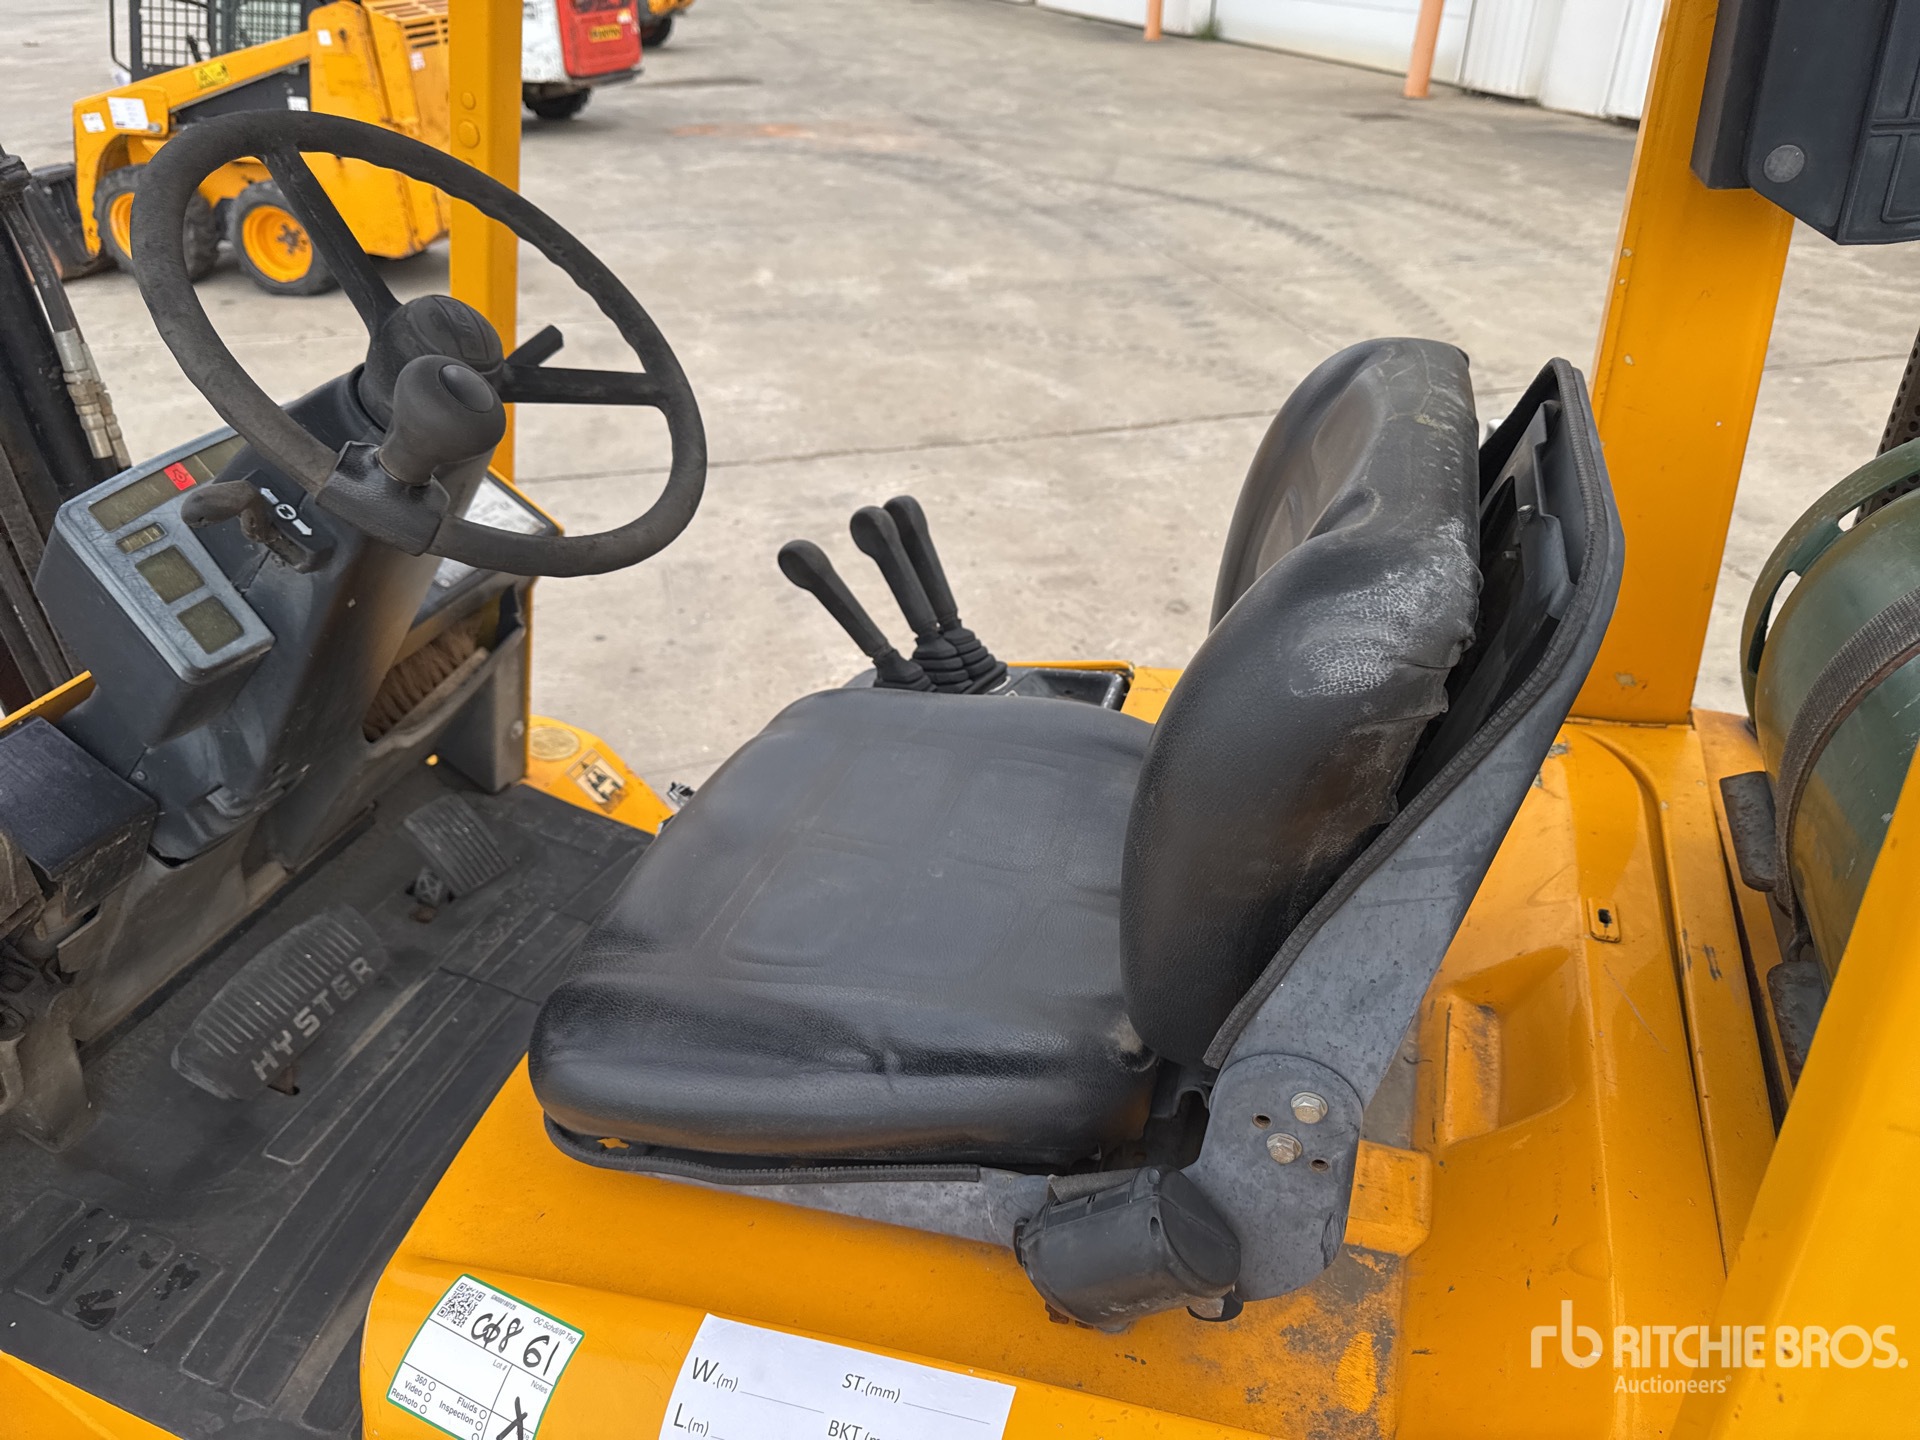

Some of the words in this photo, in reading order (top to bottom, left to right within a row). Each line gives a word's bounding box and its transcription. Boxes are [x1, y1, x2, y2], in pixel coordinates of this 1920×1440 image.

[251, 956, 375, 1081] HYSTER
[565, 1332, 577, 1345] Tag
[492, 1359, 503, 1369] Lot
[404, 1380, 423, 1397] Video
[414, 1374, 428, 1387] 360
[530, 1380, 548, 1394] Notes
[391, 1387, 419, 1409] Rephoto
[456, 1396, 478, 1414] Fluids
[439, 1400, 474, 1426] Inspection
